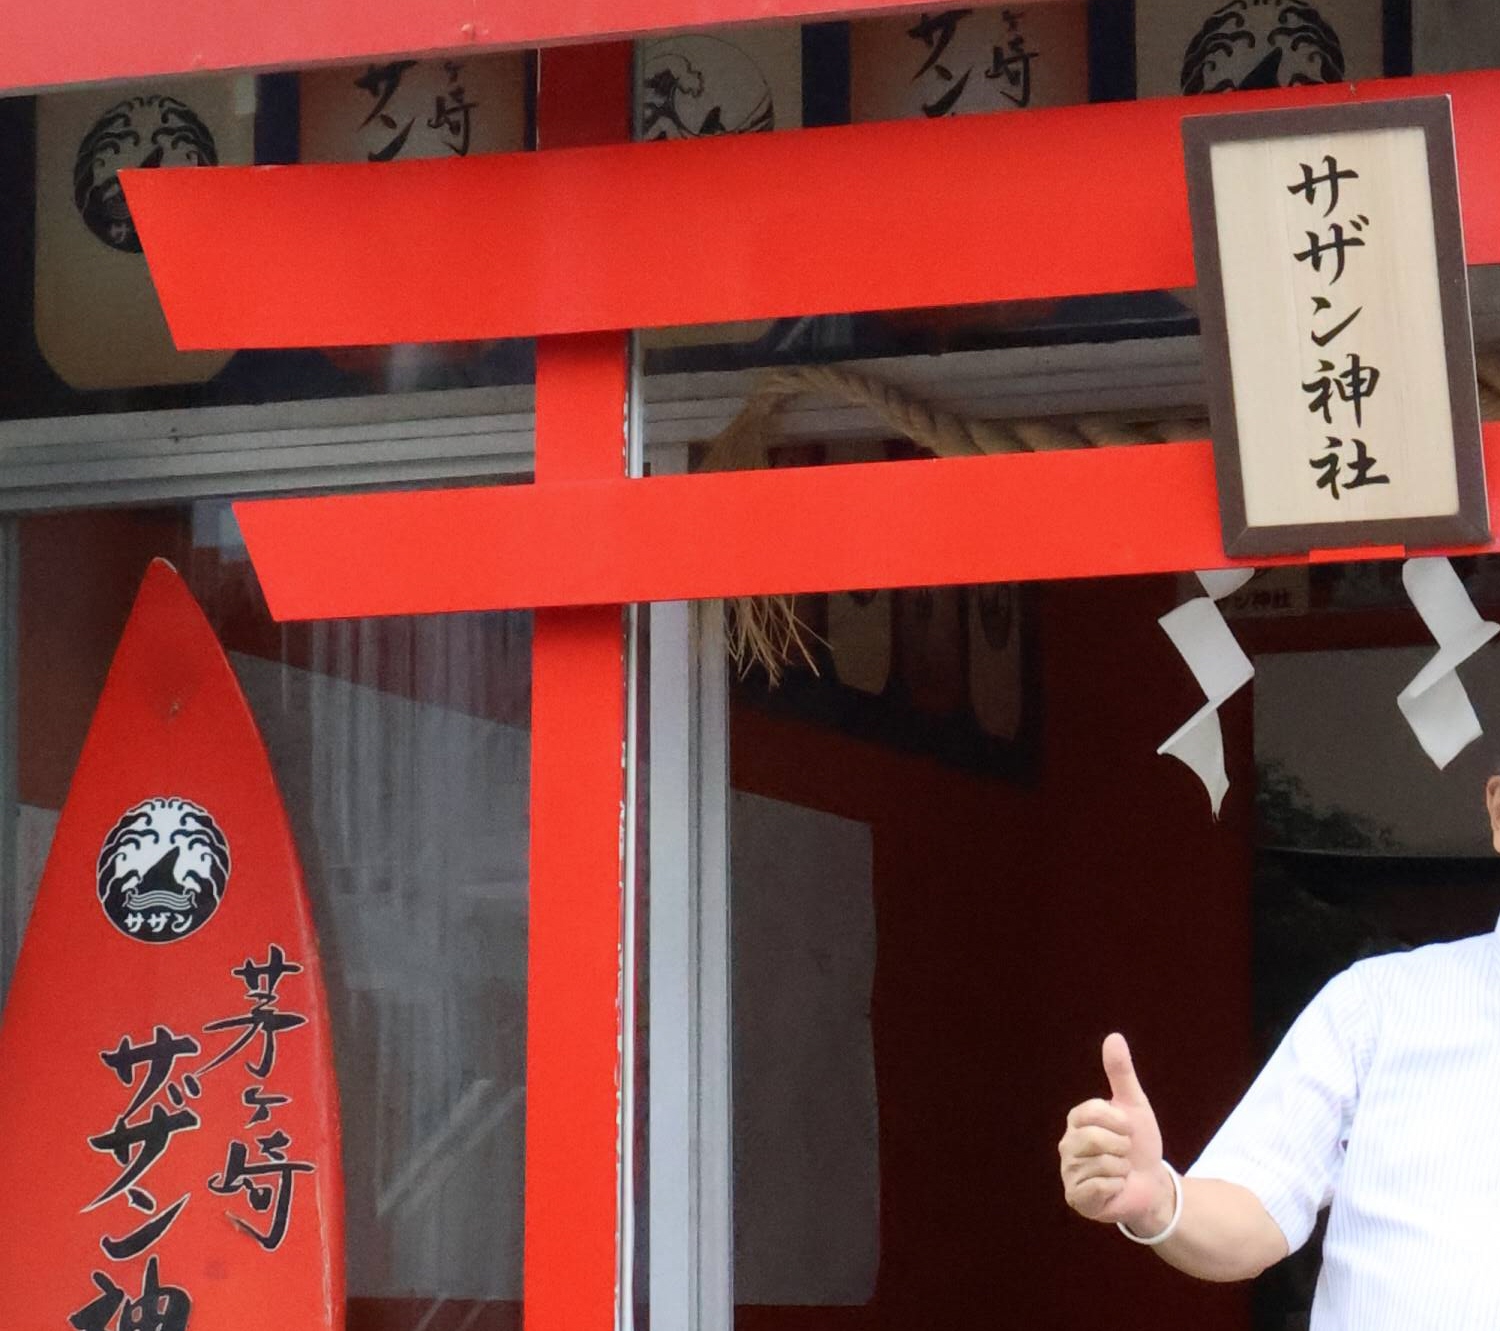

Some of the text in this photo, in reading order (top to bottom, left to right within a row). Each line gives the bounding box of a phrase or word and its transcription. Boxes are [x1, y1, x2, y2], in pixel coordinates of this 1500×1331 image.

[1287, 155, 1390, 500] サザン神社
[124, 912, 193, 932] サザン
[195, 945, 317, 1251] 茅ヶ崎
